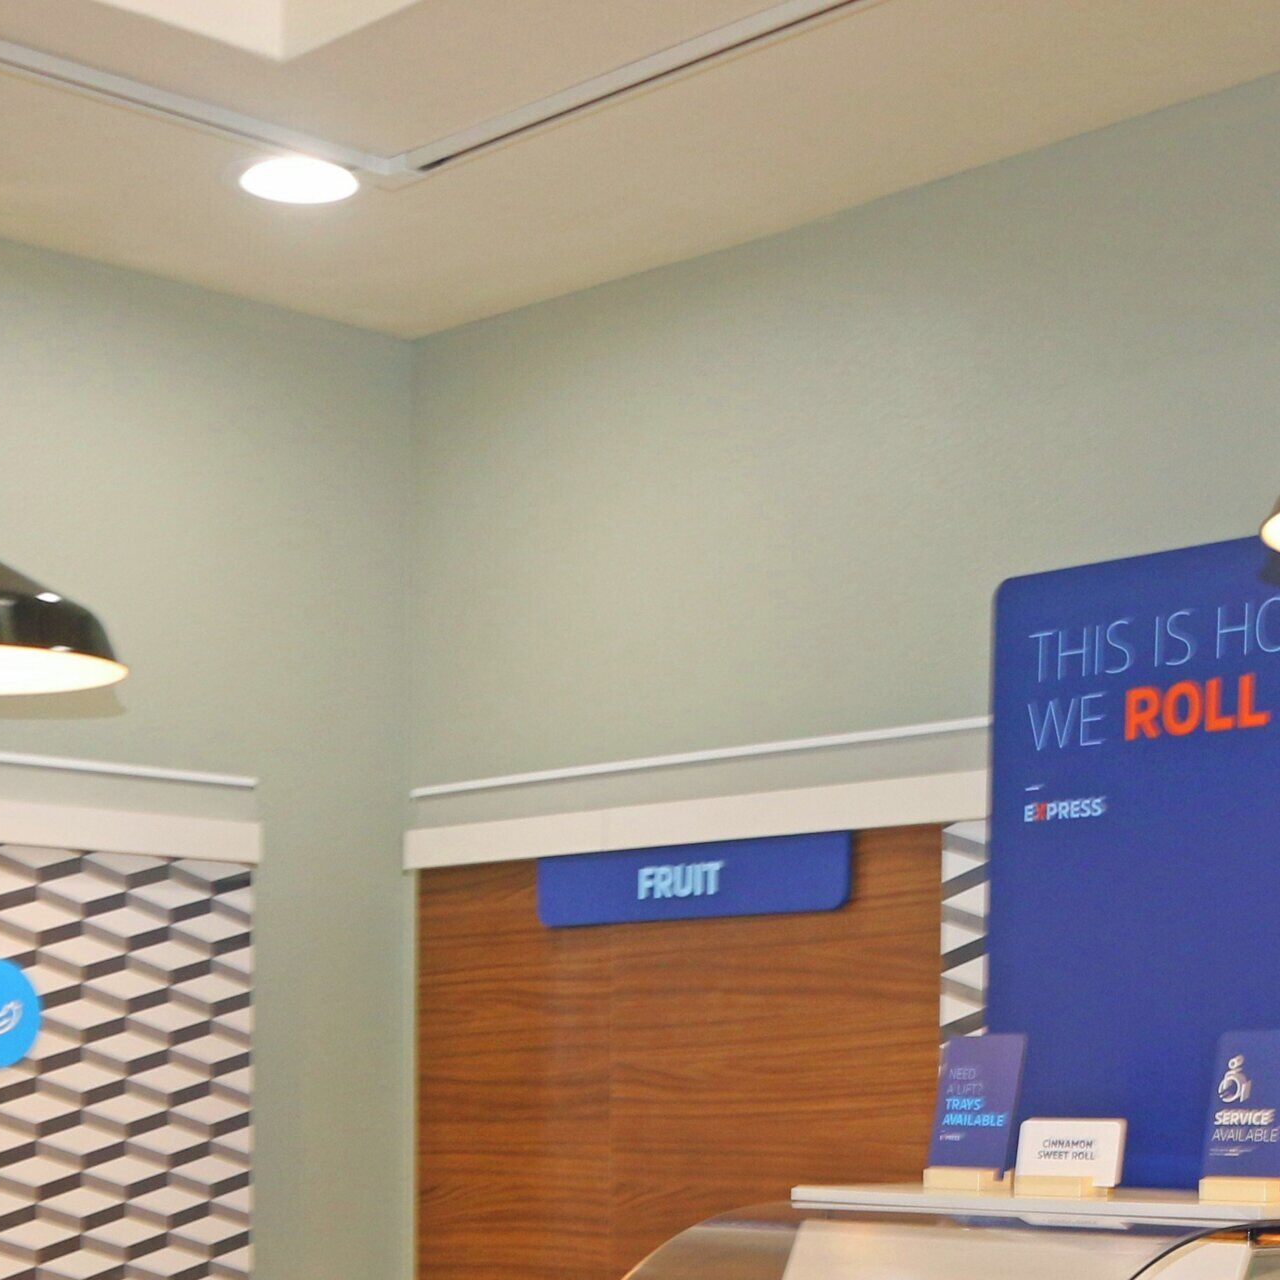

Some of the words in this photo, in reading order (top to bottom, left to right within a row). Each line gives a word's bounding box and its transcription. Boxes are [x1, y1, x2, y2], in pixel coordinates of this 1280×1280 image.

[1029, 618, 1131, 683] THIS
[1154, 610, 1193, 667] IS
[1028, 693, 1105, 751] WE
[1124, 673, 1270, 741] ROLL
[1024, 798, 1104, 823] EXPRESS
[637, 860, 723, 900] FRUIT
[948, 1068, 976, 1081] NEED
[945, 1098, 982, 1111] TRAYS
[942, 1113, 1005, 1127] AVAILABLE
[1214, 1110, 1273, 1126] SERVICE
[1212, 1128, 1279, 1142] AVAILABLE
[1042, 1138, 1094, 1149] CINNAMON
[1037, 1150, 1068, 1160] SWEET
[1071, 1150, 1096, 1160] ROLL
